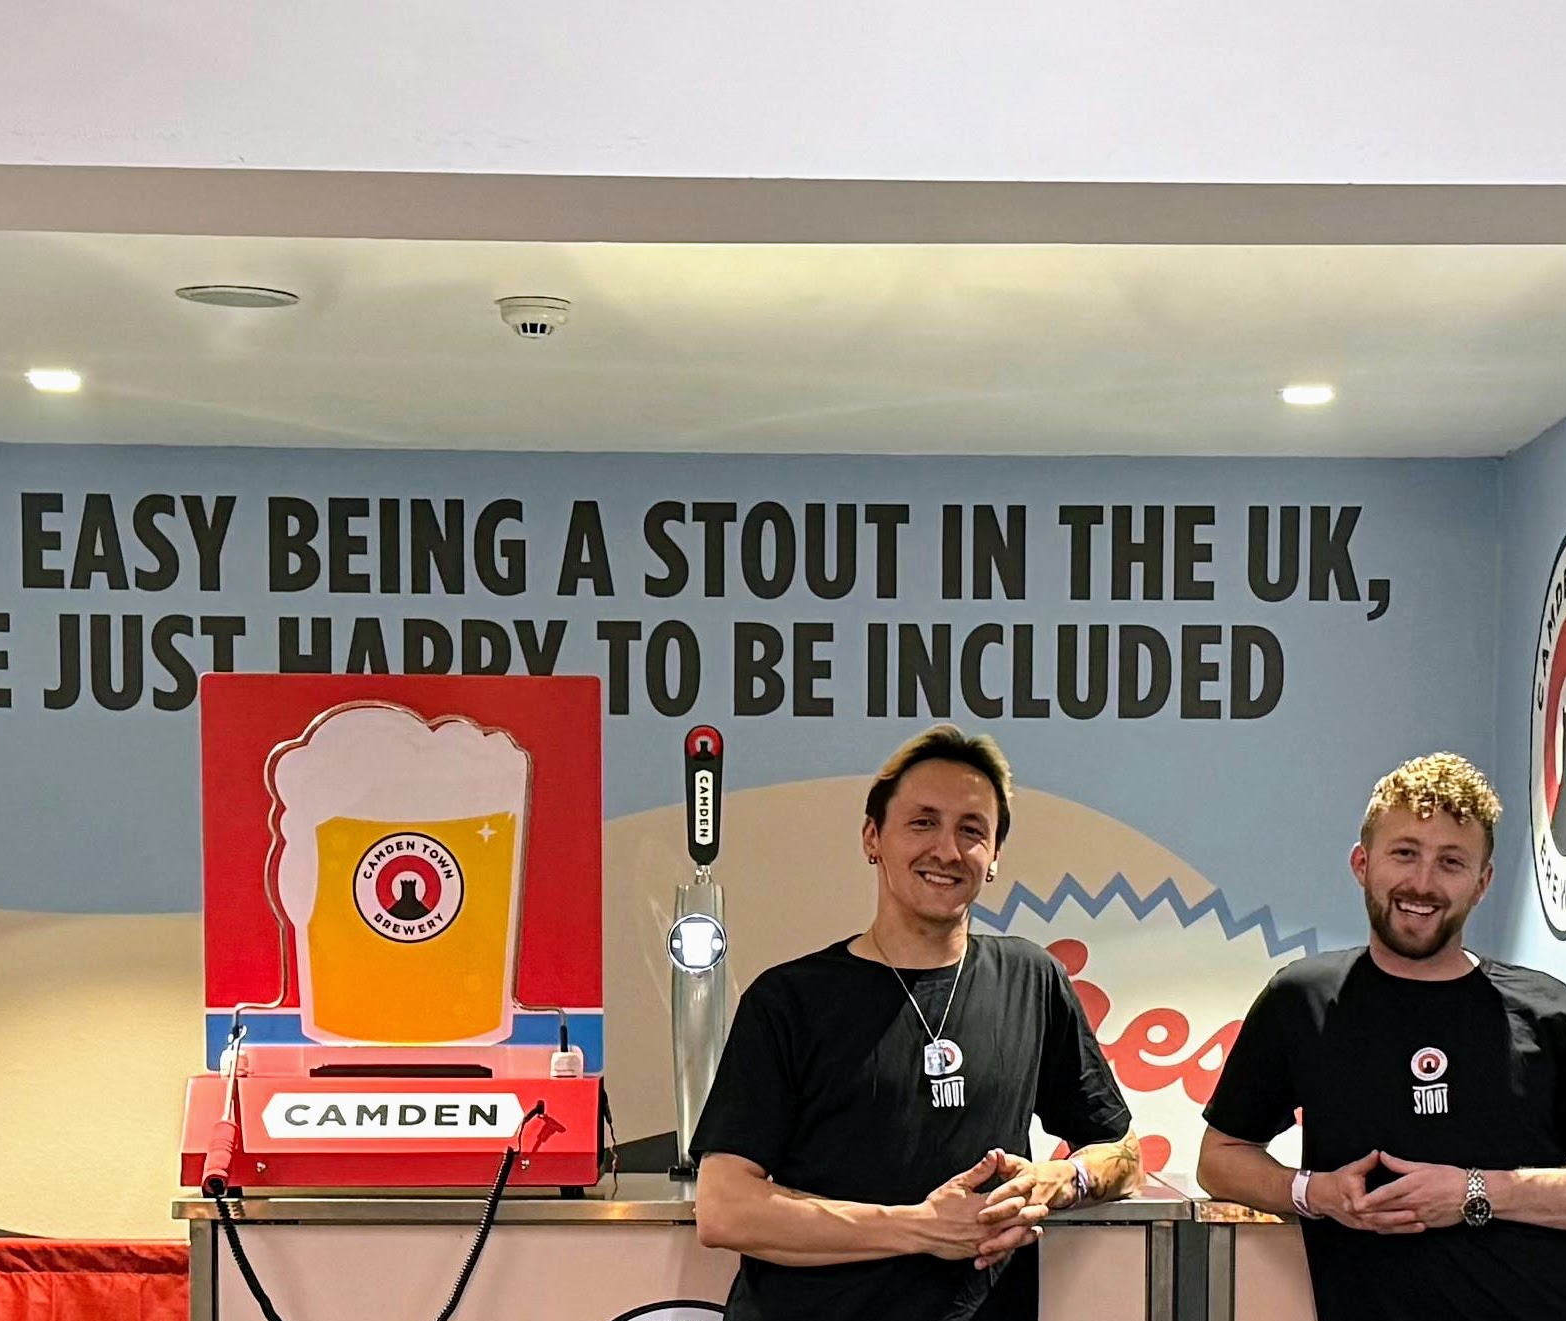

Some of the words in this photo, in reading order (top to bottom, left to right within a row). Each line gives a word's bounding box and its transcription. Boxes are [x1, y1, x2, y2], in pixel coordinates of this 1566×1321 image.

[21, 492, 237, 592] EASY
[267, 496, 527, 596] BEING
[557, 500, 615, 597] A
[643, 500, 910, 600] STOUT
[940, 504, 1027, 601] IN
[1058, 505, 1216, 602] THE
[1246, 505, 1392, 622] UK,
[43, 614, 246, 712] JUST
[597, 619, 700, 717] TO
[733, 621, 834, 718] BE
[866, 623, 1285, 720] INCLUDED
[698, 775, 710, 838] CAMDEN
[363, 841, 415, 879] CAMDEN
[422, 844, 455, 879] TOWN
[374, 912, 444, 936] BREWERY
[930, 1076, 965, 1108] STOUT
[1412, 1083, 1448, 1115] STOUT
[284, 1104, 499, 1127] CAMDEN
